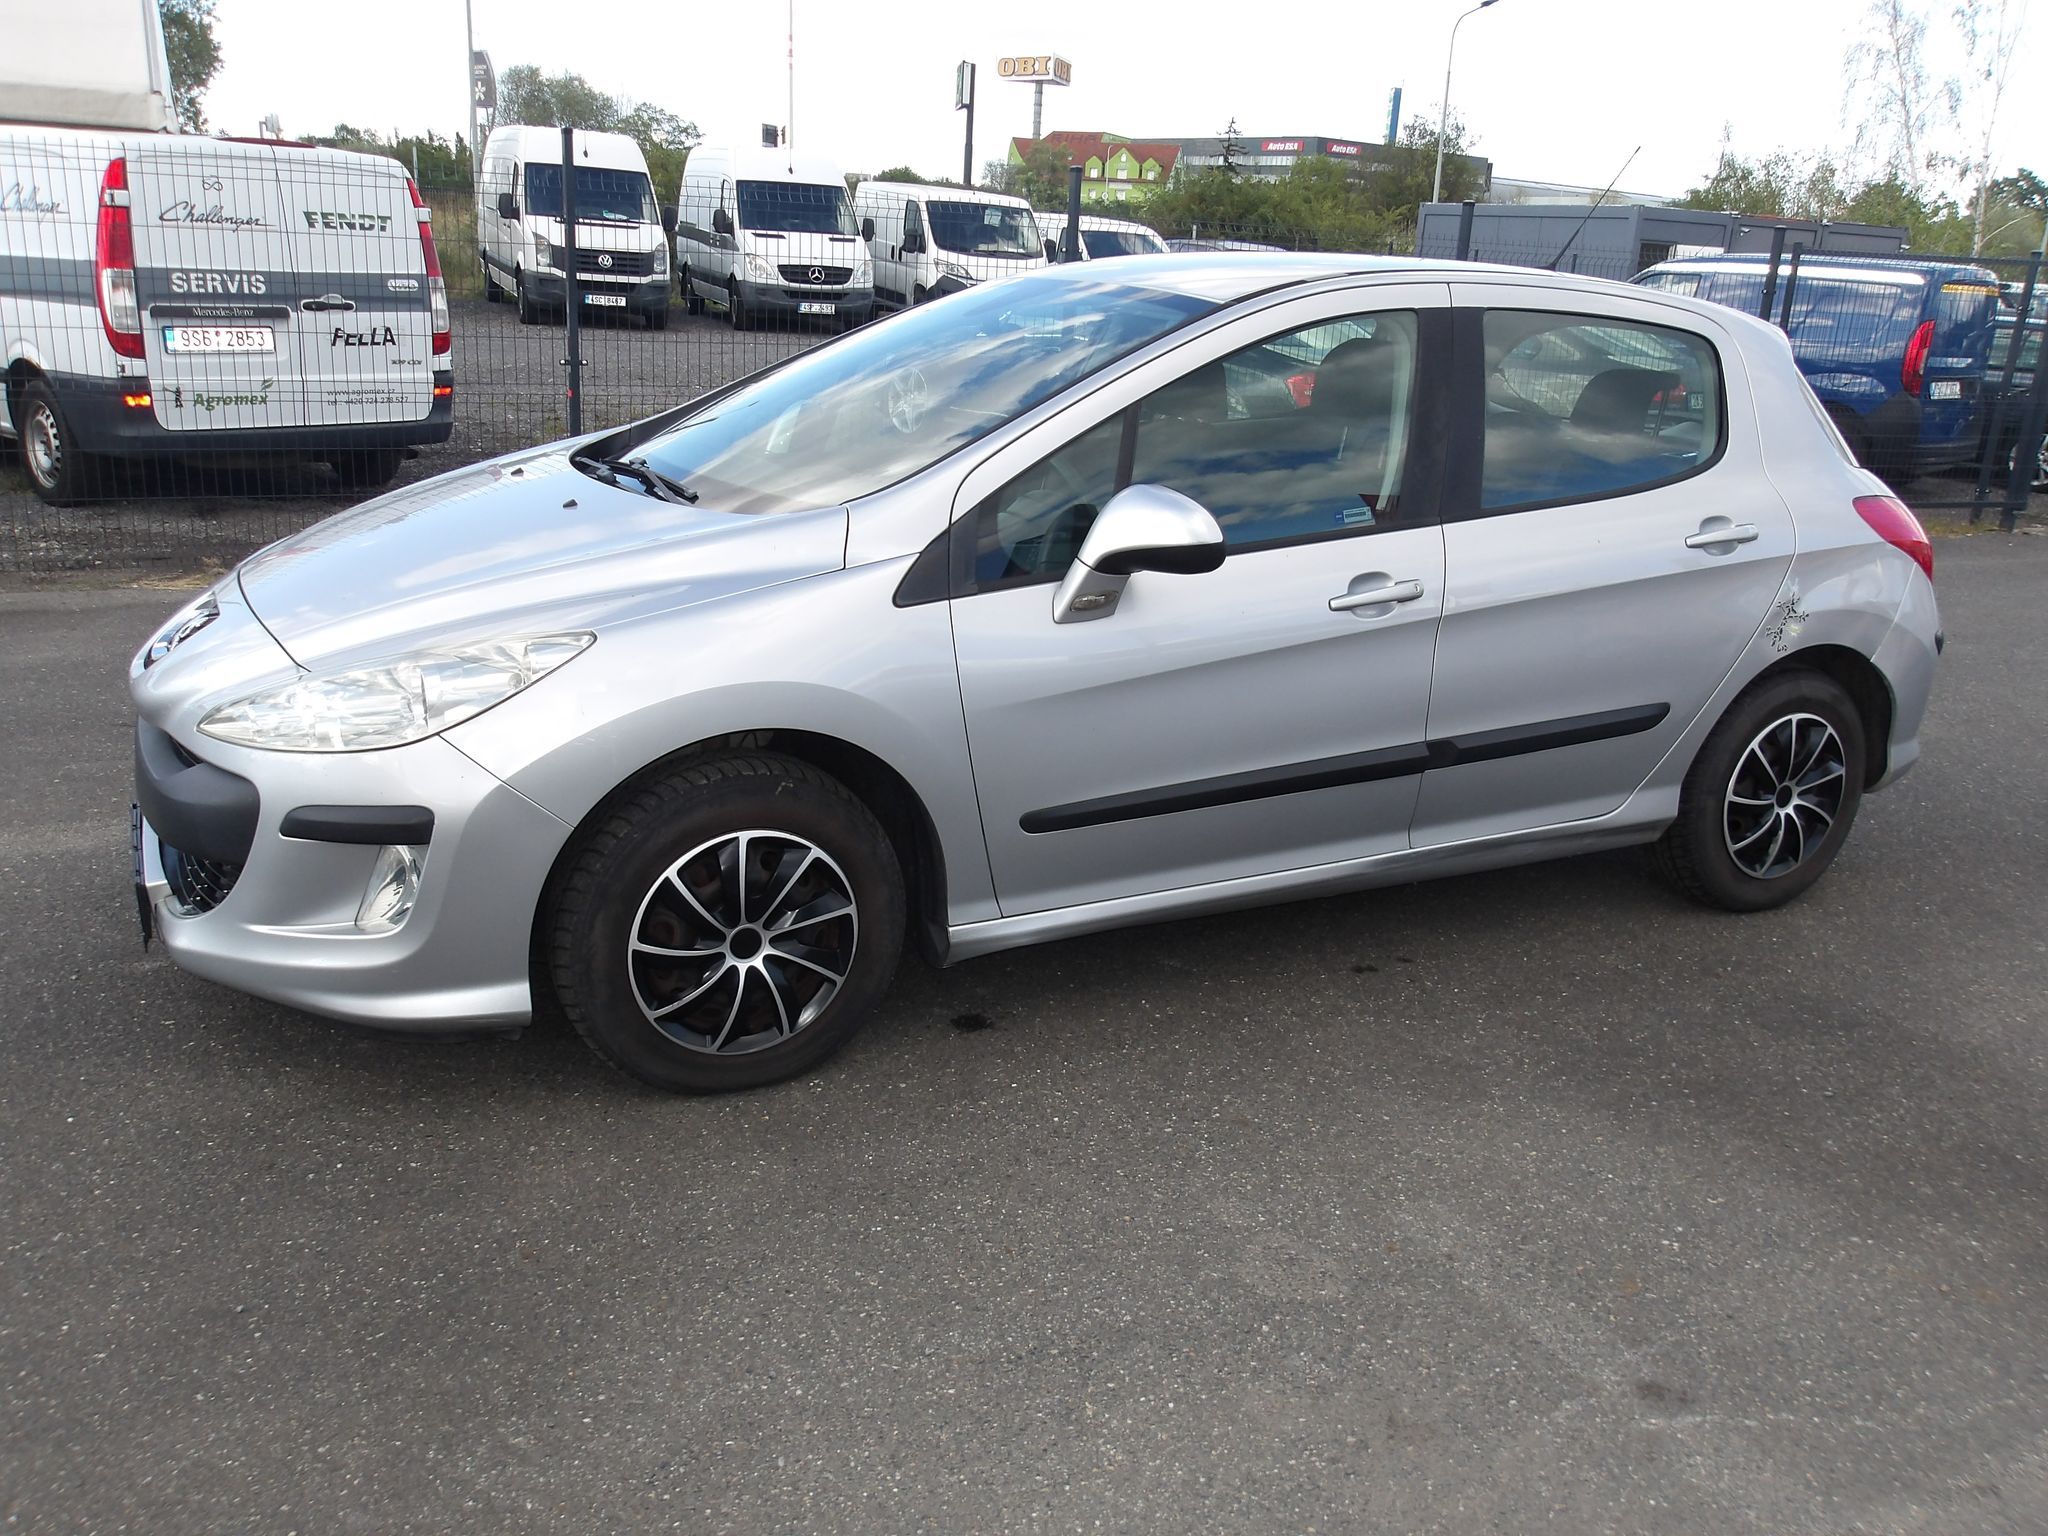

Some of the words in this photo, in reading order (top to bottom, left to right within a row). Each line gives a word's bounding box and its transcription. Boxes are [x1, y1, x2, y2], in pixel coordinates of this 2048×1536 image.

[998, 56, 1051, 76] OBI
[1055, 58, 1072, 82] OBI
[1267, 142, 1284, 151] Auto
[1285, 142, 1299, 151] ESA
[1331, 144, 1346, 153] Auto
[158, 200, 278, 233] Challenger
[303, 210, 393, 233] FENDT
[171, 272, 267, 295] SERVIS
[193, 307, 254, 317] Mercedes-Benz
[181, 330, 212, 347] 9S6
[226, 330, 266, 347] 2853
[331, 326, 397, 347] FELLA
[193, 392, 269, 412] Agromex
